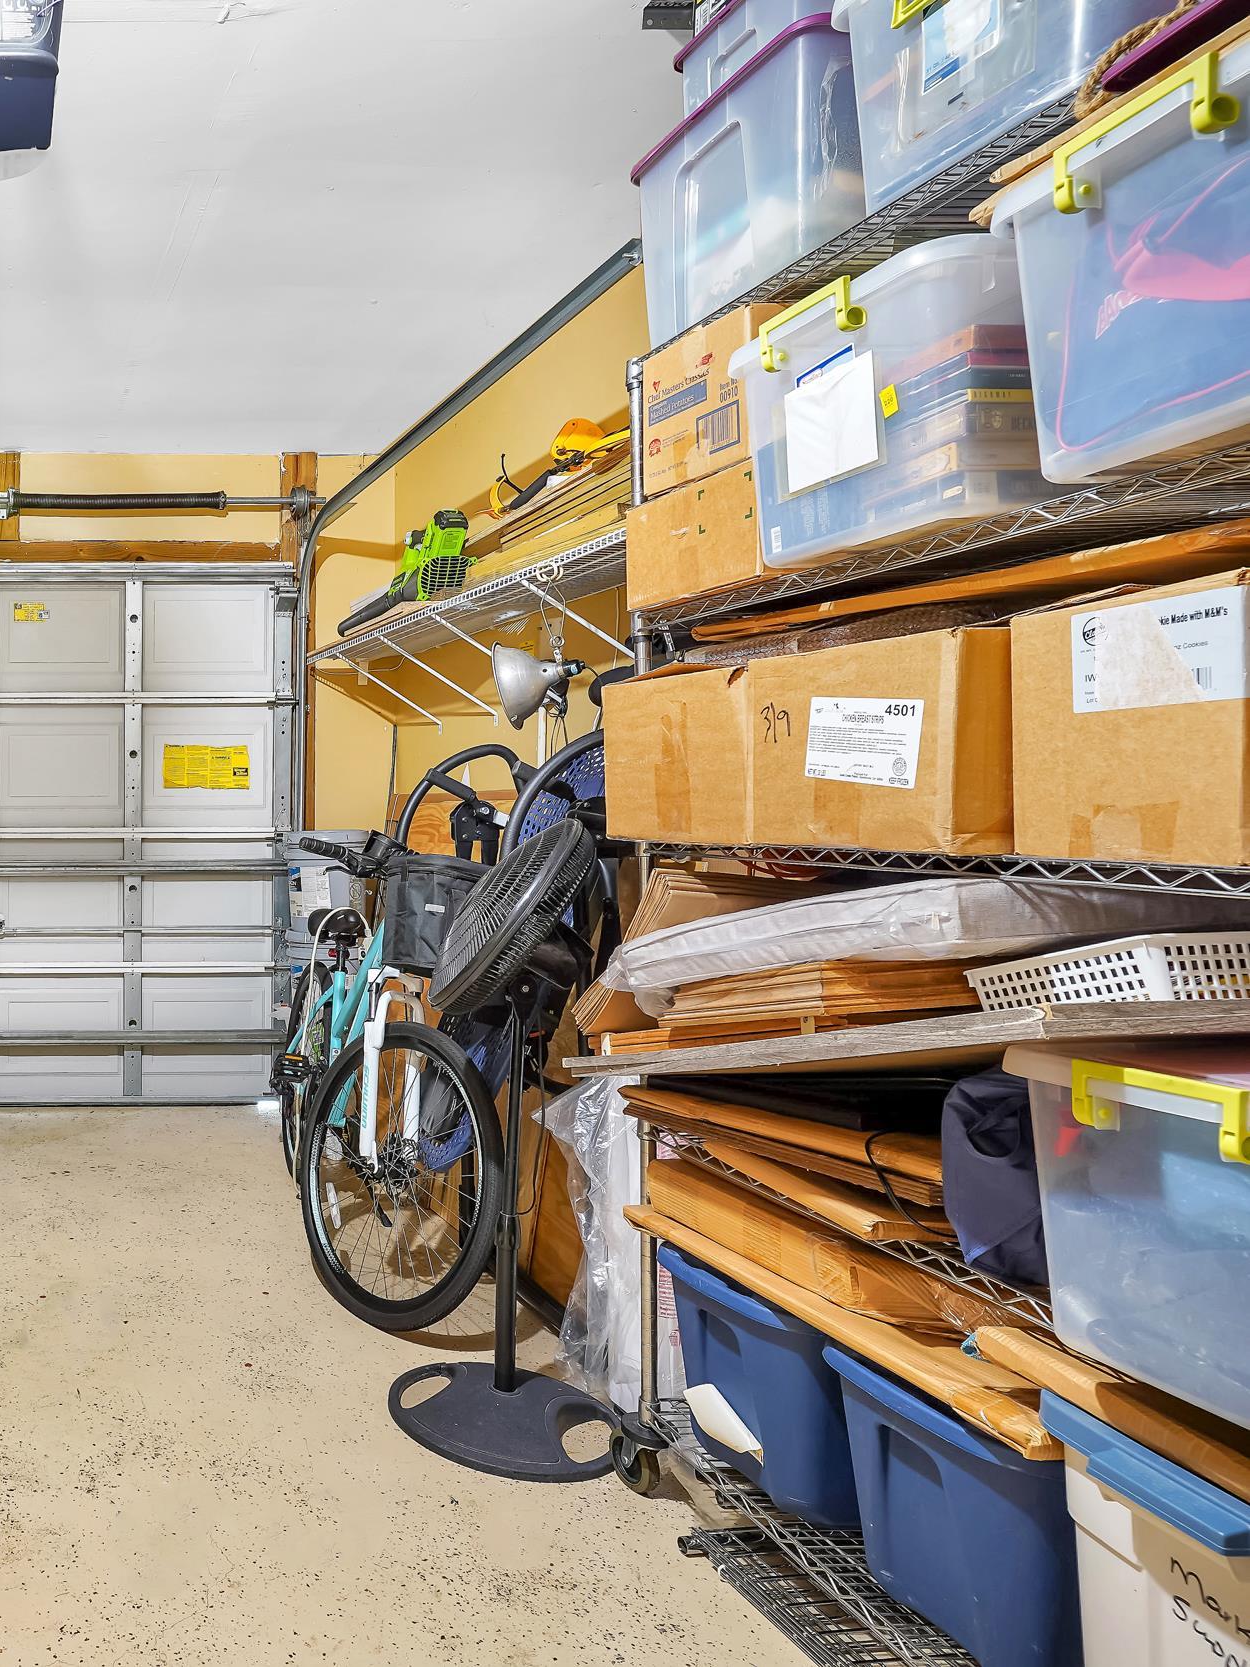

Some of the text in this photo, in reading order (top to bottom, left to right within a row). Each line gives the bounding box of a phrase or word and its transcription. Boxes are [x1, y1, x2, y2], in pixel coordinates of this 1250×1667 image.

[647, 391, 661, 404] Chef
[719, 385, 739, 404] 00910
[650, 393, 695, 417] Mashed Potatoes
[1170, 613, 1188, 626] Made
[1189, 611, 1203, 621] with
[1204, 606, 1228, 618] M&M's
[1182, 640, 1209, 650] Cookies
[884, 704, 916, 717] 4501
